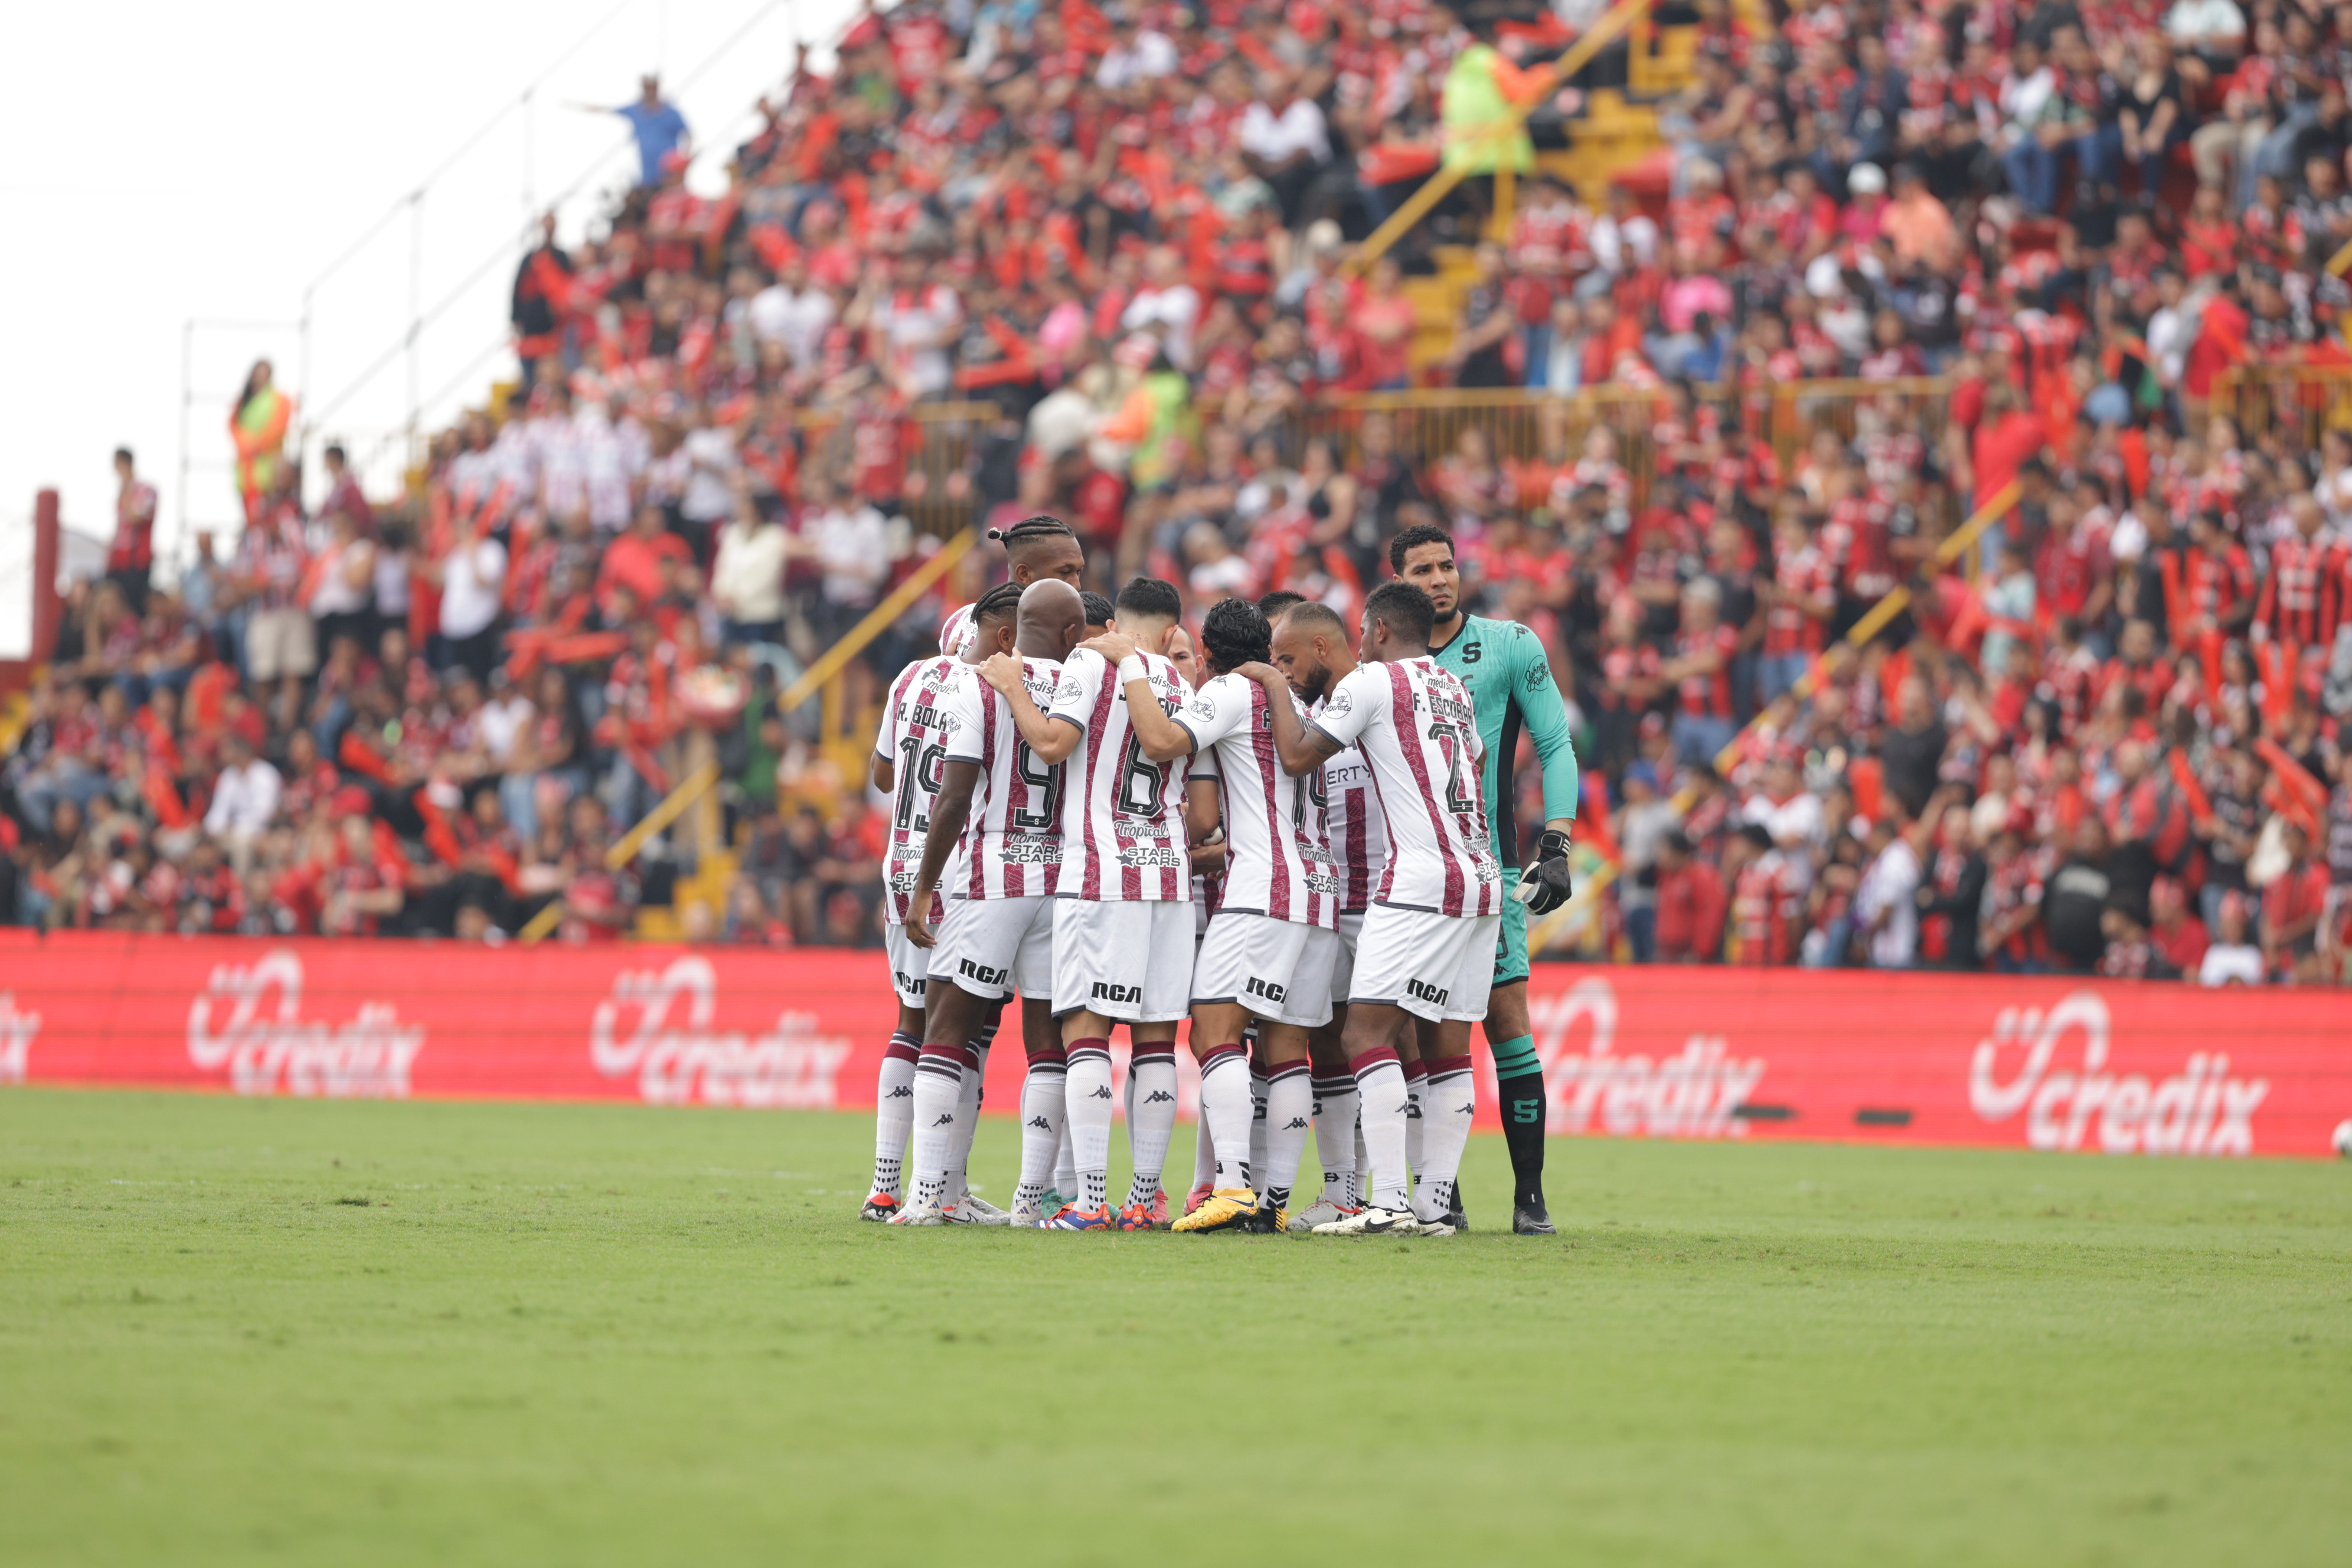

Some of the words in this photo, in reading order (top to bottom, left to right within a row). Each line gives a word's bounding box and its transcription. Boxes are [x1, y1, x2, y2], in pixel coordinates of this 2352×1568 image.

[1462, 641, 1481, 664] S
[897, 703, 908, 721] R.
[1014, 739, 1060, 829] 9
[1117, 730, 1162, 818] 6
[1113, 821, 1168, 839] Tropical
[1010, 844, 1056, 854] STAR
[1018, 854, 1063, 863] CARS
[1127, 848, 1171, 857] STAR
[1135, 856, 1181, 867] CARS
[959, 958, 1008, 985] RCA
[1091, 982, 1142, 1004] RCA
[1407, 978, 1449, 1006] RCA
[1513, 1099, 1538, 1123] S
